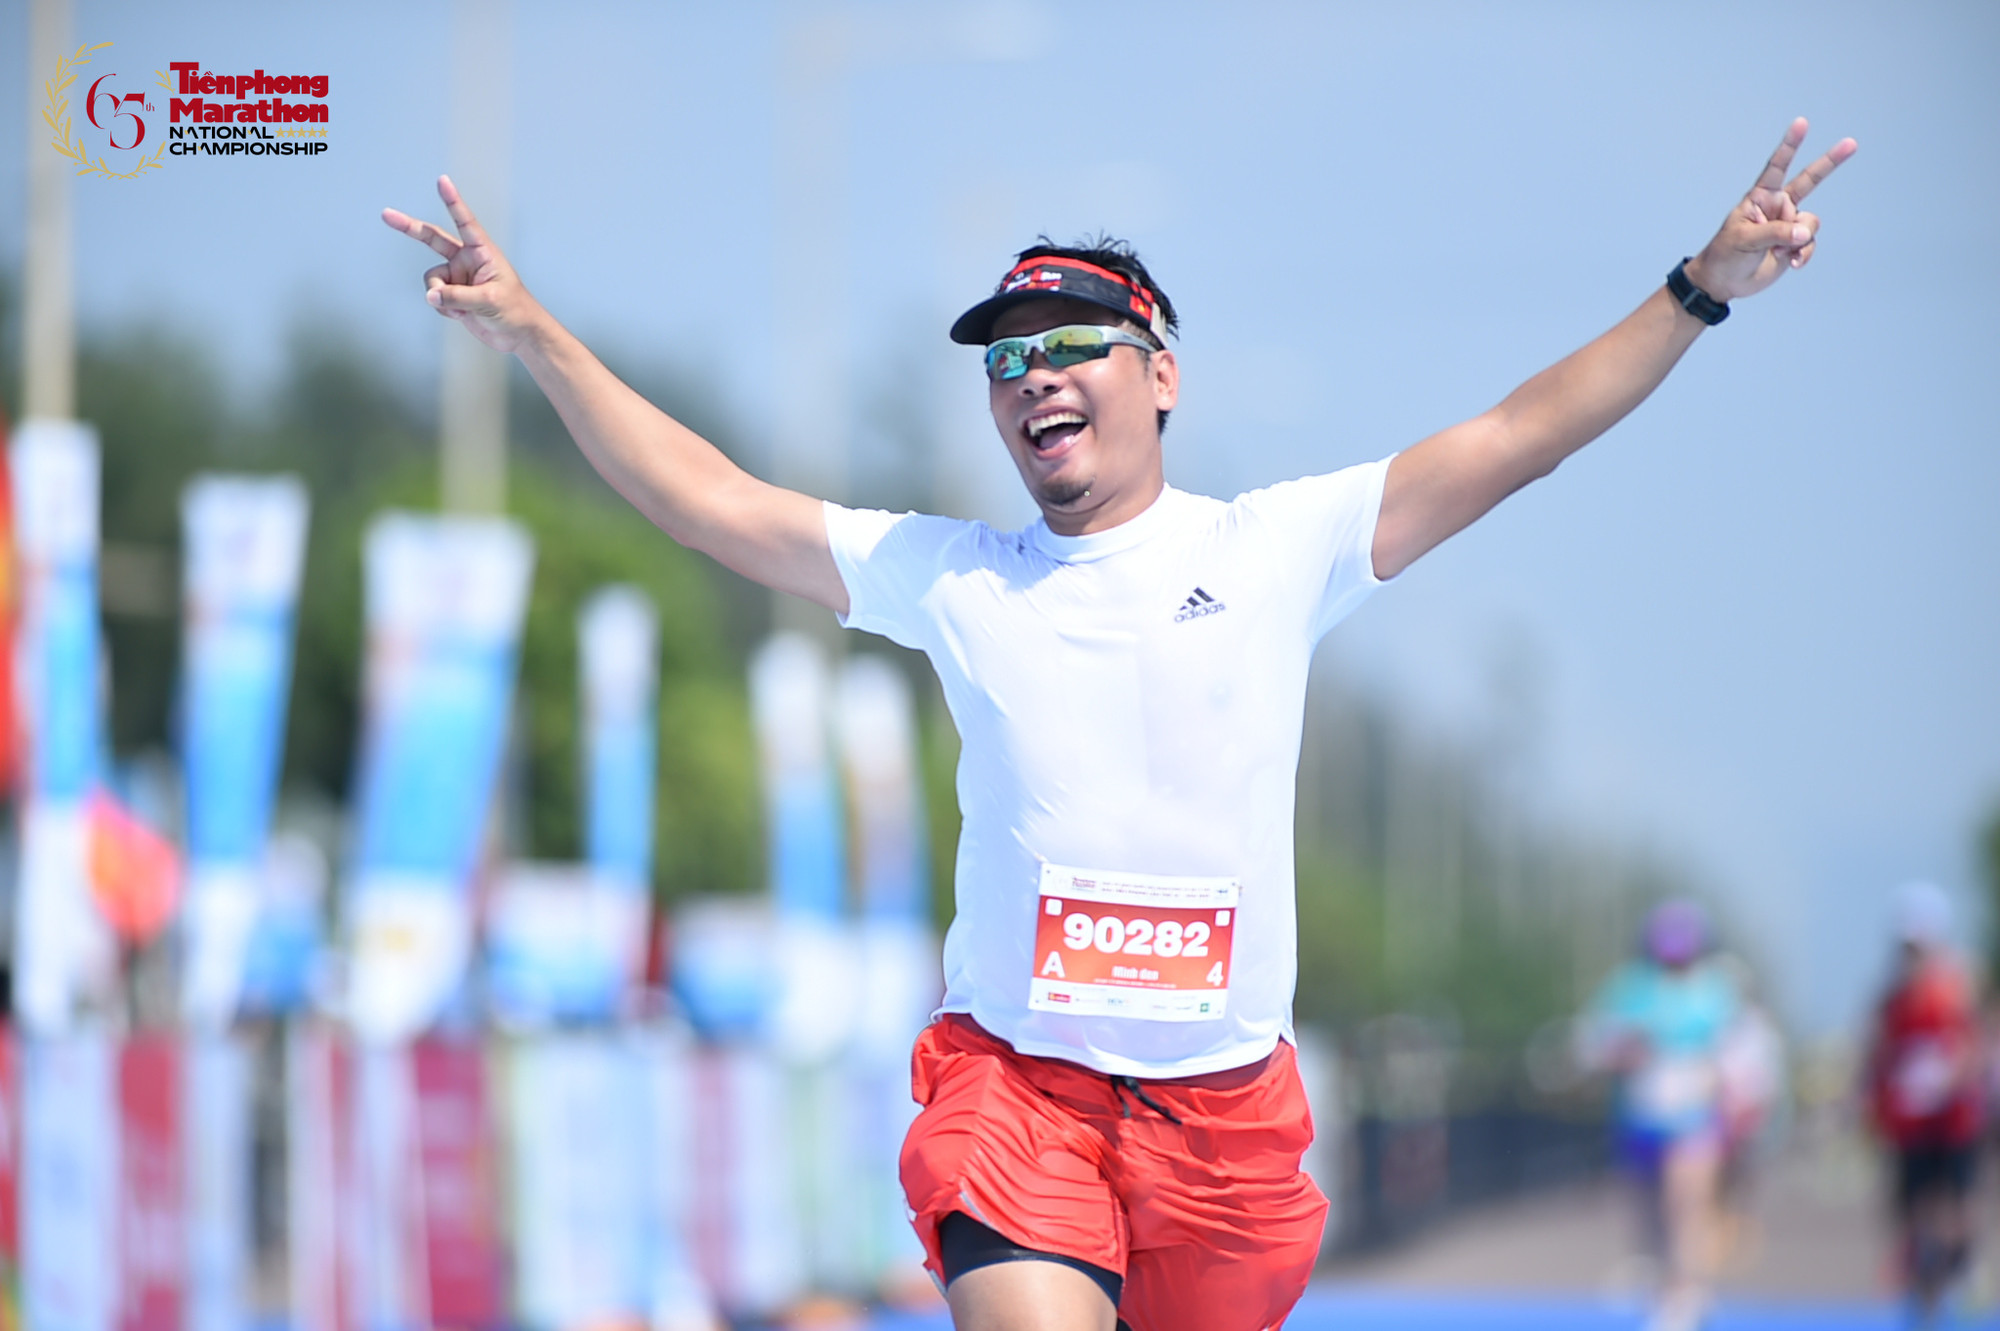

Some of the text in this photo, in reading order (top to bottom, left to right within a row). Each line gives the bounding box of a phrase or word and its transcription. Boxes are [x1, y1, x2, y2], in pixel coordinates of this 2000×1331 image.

[1174, 603, 1226, 623] adidas
[1063, 912, 1211, 958] 90282
[1040, 950, 1066, 979] A
[1206, 961, 1223, 986] 4
